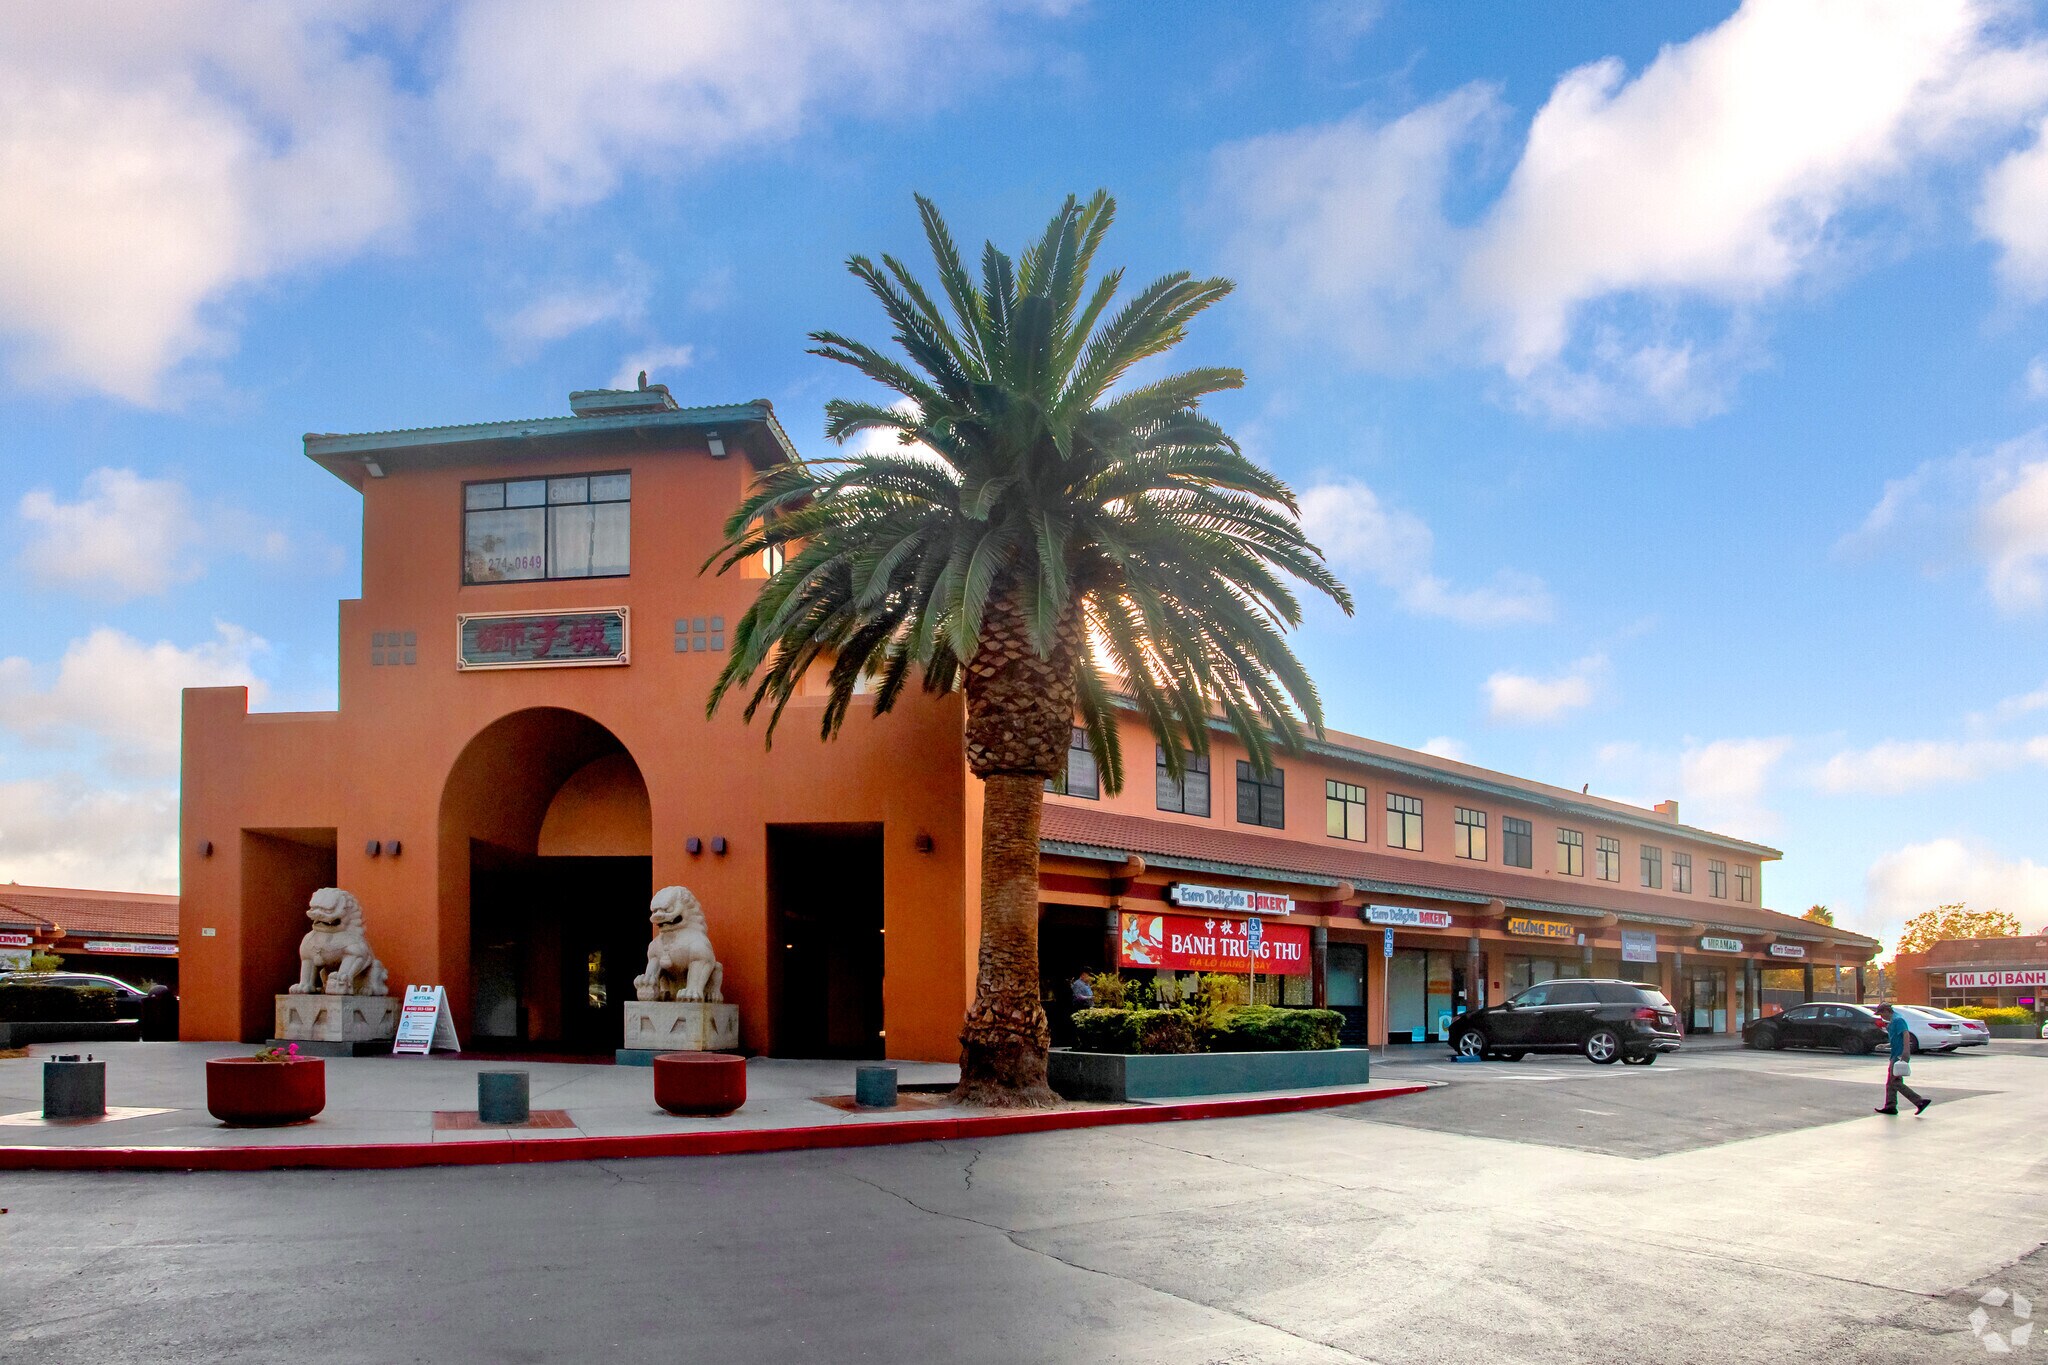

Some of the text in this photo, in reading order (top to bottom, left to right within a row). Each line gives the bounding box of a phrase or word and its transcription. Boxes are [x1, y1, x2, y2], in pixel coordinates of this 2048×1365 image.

[1181, 887, 1288, 912] Euro Delights BAKERY
[1371, 907, 1447, 926] Euro Delights BAKERY
[1171, 933, 1216, 956] BÁNH
[1273, 941, 1301, 960] THU
[1707, 938, 1737, 951] MIRAMAR
